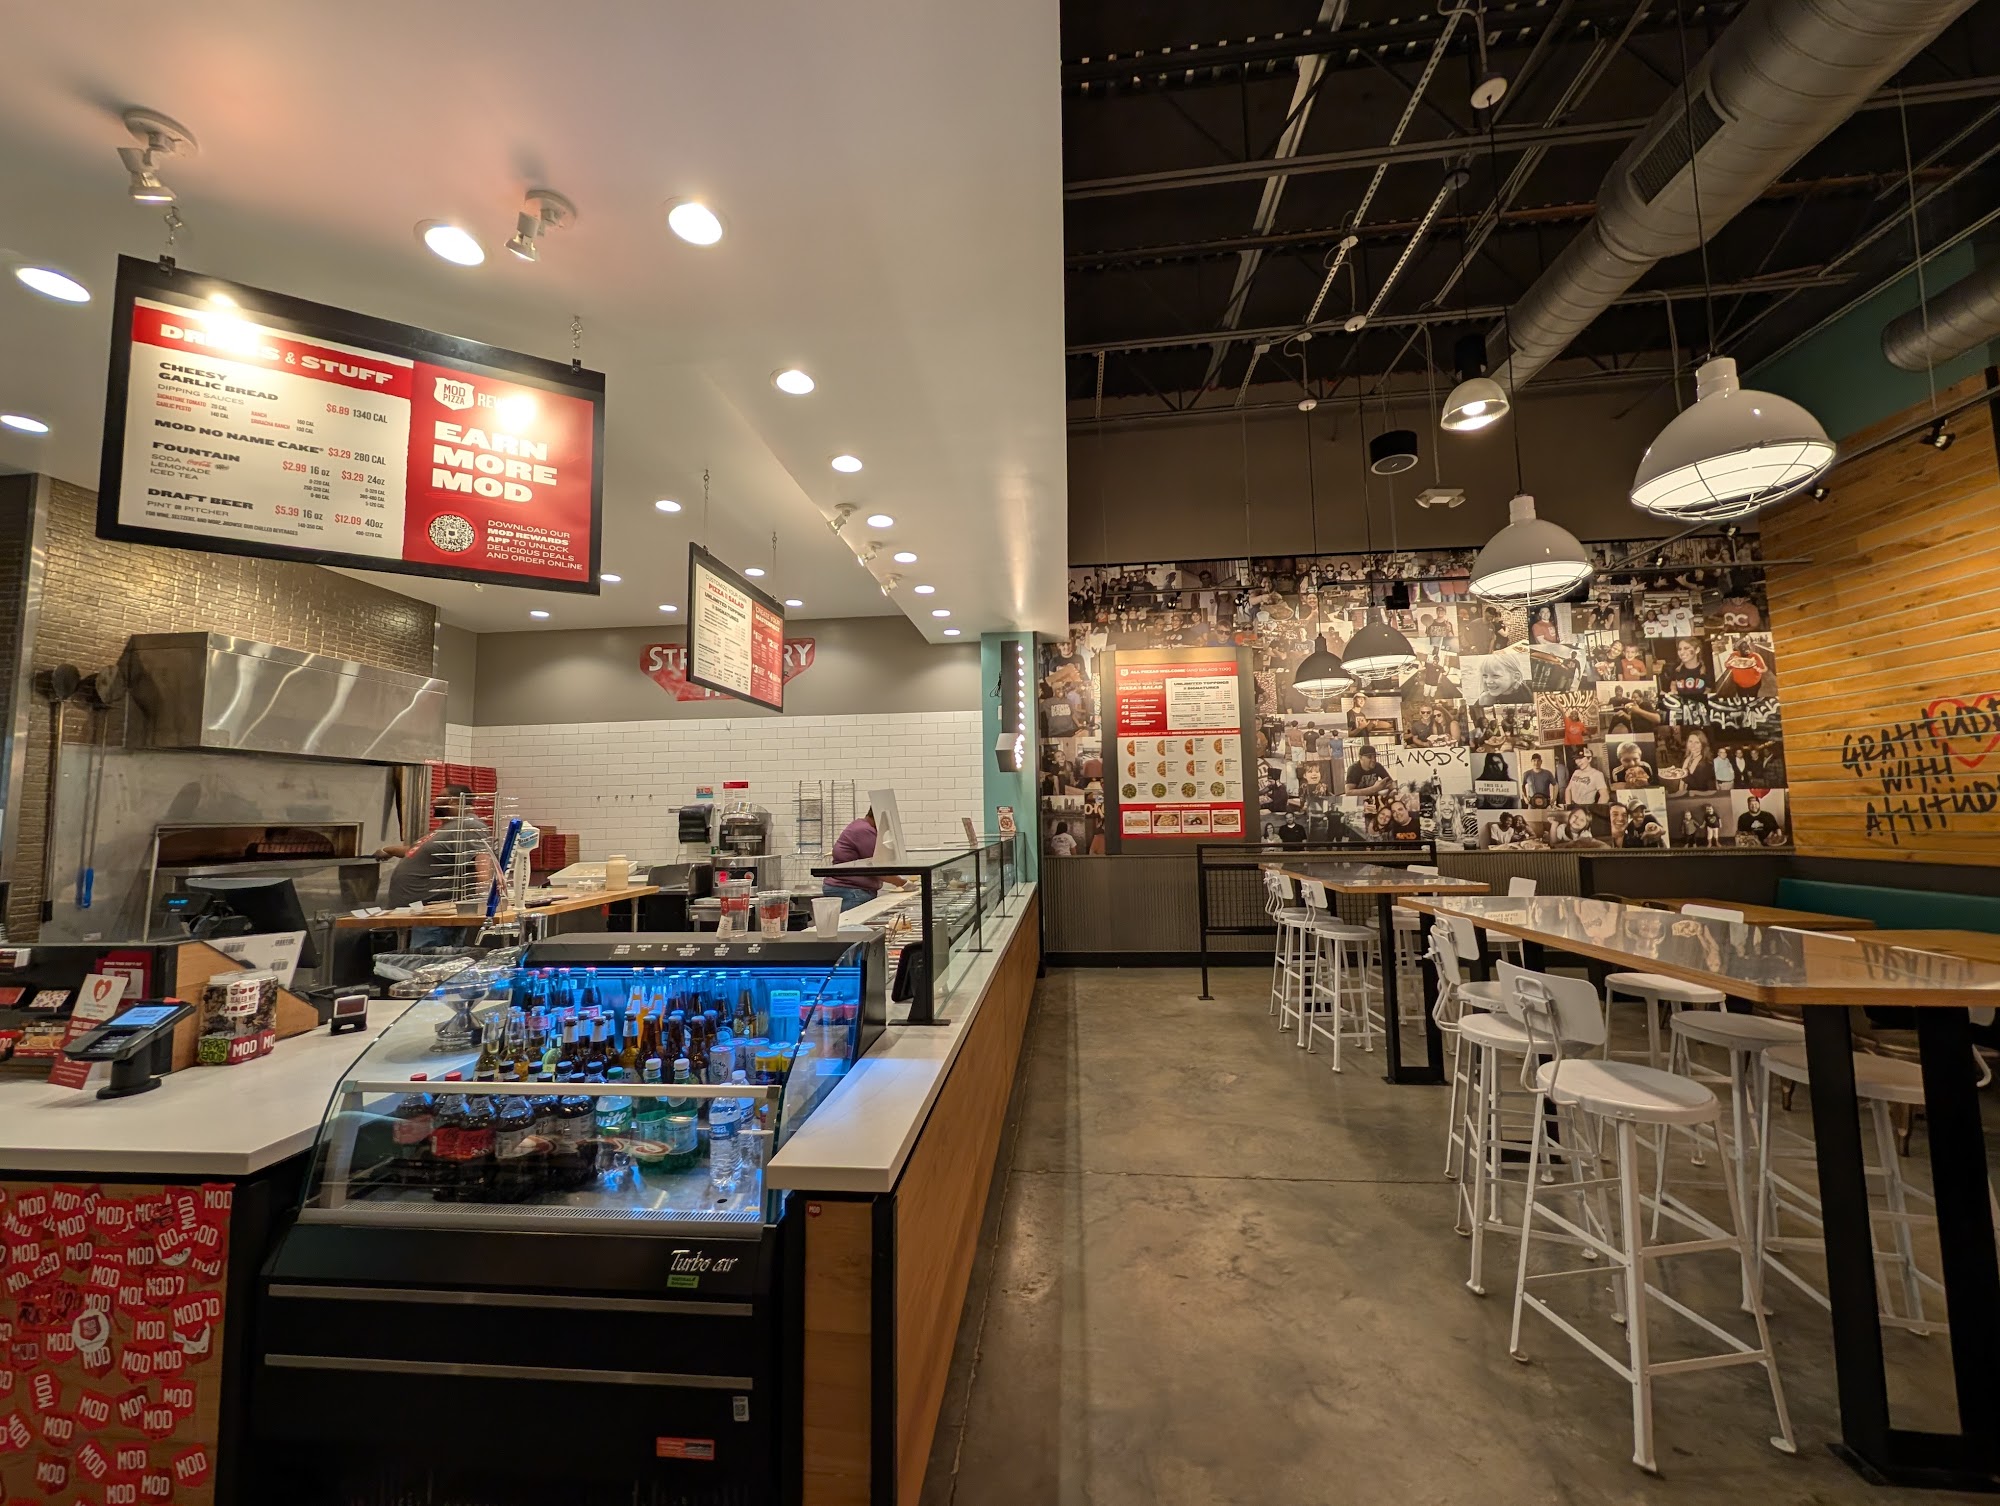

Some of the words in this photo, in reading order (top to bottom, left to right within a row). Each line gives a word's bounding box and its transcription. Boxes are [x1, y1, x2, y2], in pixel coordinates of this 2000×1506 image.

[160, 362, 227, 381] CHEESY
[284, 352, 296, 365] &
[301, 356, 393, 385] STUFF
[158, 372, 221, 390] GARLIC
[225, 386, 279, 401] BREAD
[158, 384, 201, 397] DIPPING
[204, 392, 245, 405] SAUCES
[443, 383, 466, 398] MOD
[176, 404, 192, 412] PESTO
[186, 398, 207, 408] TOMATO
[442, 394, 465, 406] PIZZA
[326, 404, 350, 416] $6.89
[352, 409, 372, 420] 1340
[373, 414, 388, 424] CAL
[154, 419, 196, 433] MOD
[199, 428, 224, 437] NO
[226, 432, 275, 447] NAME
[328, 447, 351, 459] $3.29
[354, 452, 370, 463] 280
[372, 455, 387, 466] CAL
[434, 420, 548, 461] EARN
[152, 442, 240, 462] FOUNTAIN
[152, 454, 181, 463] SODA
[150, 460, 211, 475] LEMONADE
[150, 468, 175, 477] ICED
[178, 472, 199, 480] TEA
[282, 460, 307, 473] $2.99
[310, 466, 320, 475] 16
[342, 470, 364, 482] $3.29
[434, 444, 558, 486] MORE
[432, 468, 533, 503] MOD
[146, 500, 172, 509] PINT
[184, 506, 229, 517] PITCHER
[148, 488, 207, 503] DRAFT
[210, 497, 254, 510] BEER
[274, 504, 299, 517] $5.39
[303, 510, 313, 519] 16
[334, 514, 362, 526] $12.09
[254, 524, 272, 532] CHILLED
[272, 528, 298, 536] BEVERAGES
[487, 528, 514, 538] MOD
[516, 531, 569, 546] REWARDS
[488, 520, 547, 536] DOWNLOAD
[550, 530, 571, 539] OUR
[486, 536, 510, 545] APP
[512, 539, 526, 547] TO
[528, 541, 569, 553] UNLOCK
[486, 544, 541, 557] DELICIOUS
[542, 551, 575, 562] DEALS
[486, 552, 509, 561] AND
[511, 554, 545, 566] ORDER
[548, 560, 583, 571] ONLINE
[704, 592, 728, 609] UNLIMITED
[728, 606, 746, 620] TOPPINGS
[708, 582, 725, 598] PIZZA
[728, 596, 745, 609] SALAD
[1396, 754, 1405, 768] A
[1880, 742, 1955, 794] WITH
[1866, 774, 2000, 845] ATTITUD
[232, 1039, 258, 1058] MOD
[19, 1196, 46, 1218] MOD
[204, 1190, 233, 1209] MOD
[808, 1206, 821, 1214] MOD
[96, 1206, 125, 1225] MOD
[178, 1196, 198, 1231] MOD
[57, 1214, 86, 1239] MOD
[12, 1242, 40, 1264] MOD
[66, 1242, 93, 1261] MOD
[126, 1246, 155, 1266] MOD
[670, 1250, 712, 1272] Turbo
[712, 1258, 739, 1272] air
[91, 1264, 120, 1288] MOD
[146, 1276, 175, 1297] MOD
[173, 1302, 203, 1328] MOD
[136, 1320, 166, 1341] MOD
[46, 1332, 75, 1352] MOD
[122, 1350, 151, 1374] MOD
[153, 1350, 183, 1371] MOD
[34, 1374, 55, 1409] MOD
[164, 1388, 193, 1408] MOD
[80, 1396, 110, 1422] MOD
[43, 1416, 73, 1440] MOD
[144, 1410, 173, 1430] MOD
[8, 1414, 32, 1449] MOD
[78, 1444, 108, 1479] MOD
[117, 1450, 147, 1471] MOD
[176, 1452, 207, 1480] MOD
[37, 1462, 66, 1484] MOD
[106, 1484, 136, 1505] MOD
[141, 1475, 170, 1496] MOD
